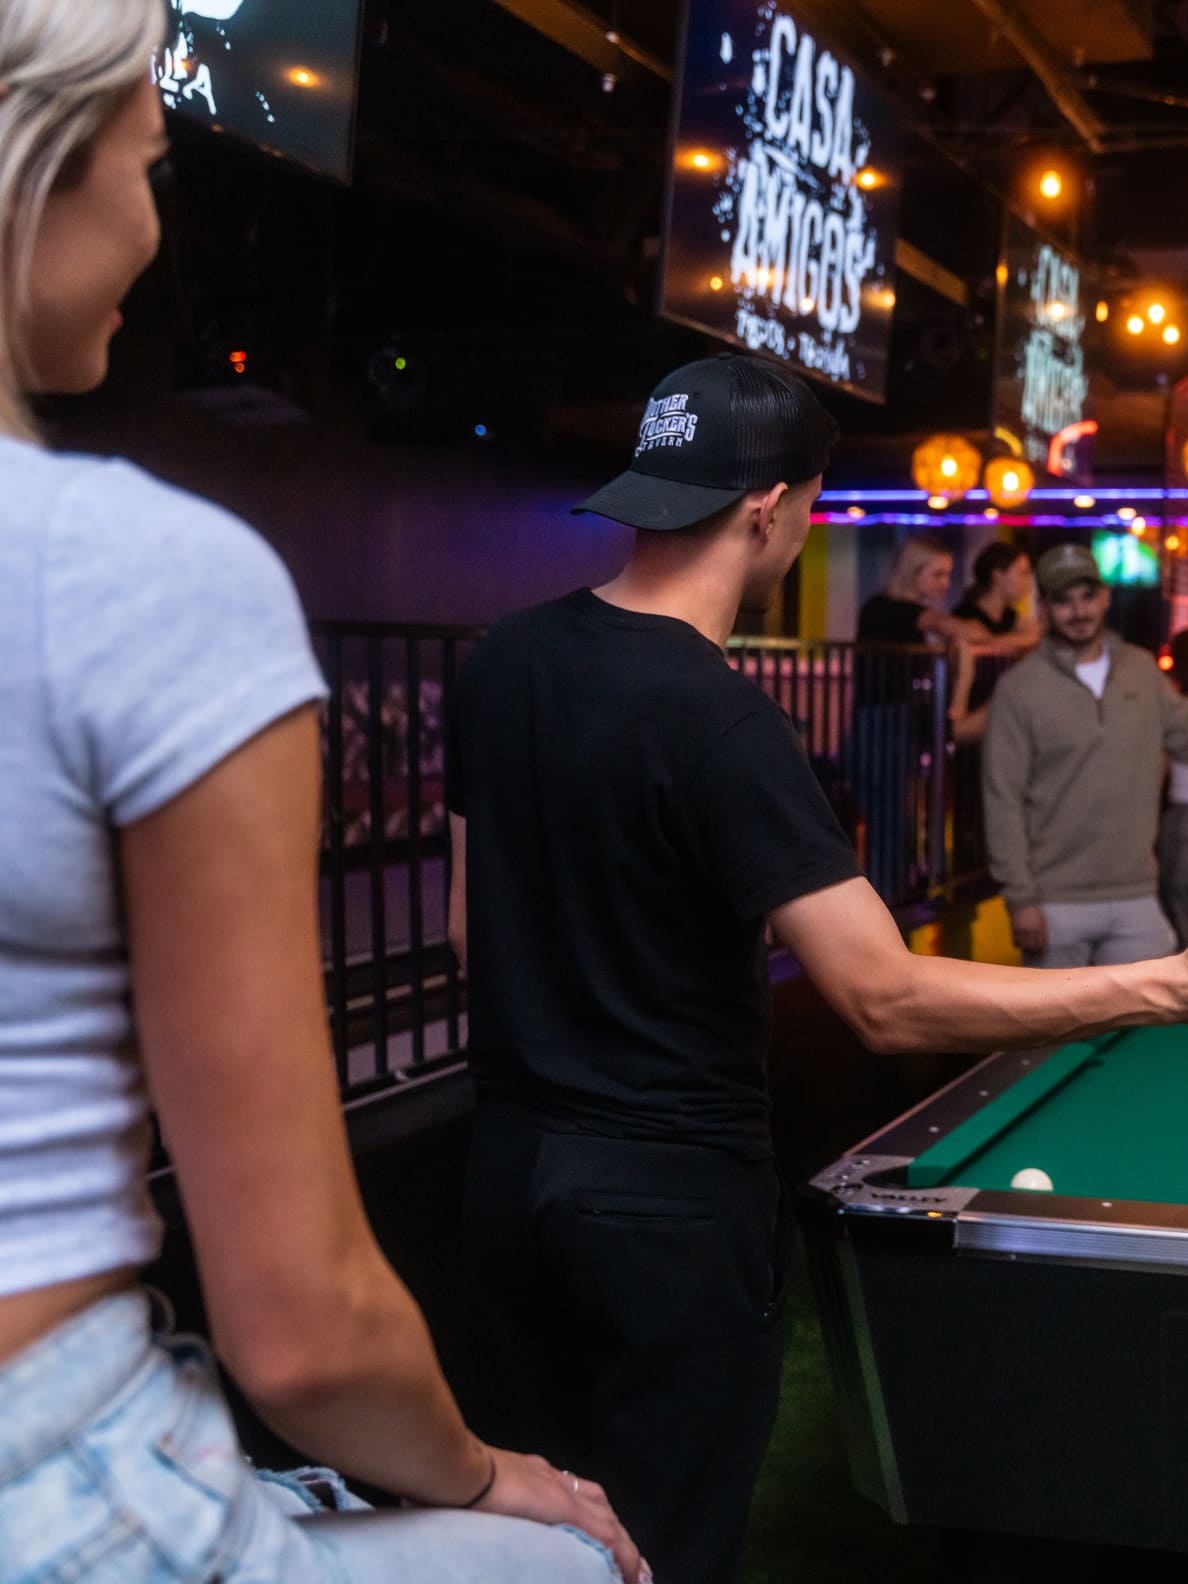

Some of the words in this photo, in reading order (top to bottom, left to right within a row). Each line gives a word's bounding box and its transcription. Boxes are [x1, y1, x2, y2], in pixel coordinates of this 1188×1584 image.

[766, 15, 855, 180] CASA
[730, 160, 867, 333] AMIGOS
[635, 412, 698, 458] TUCKER'S
[643, 437, 683, 451] TAVERN
